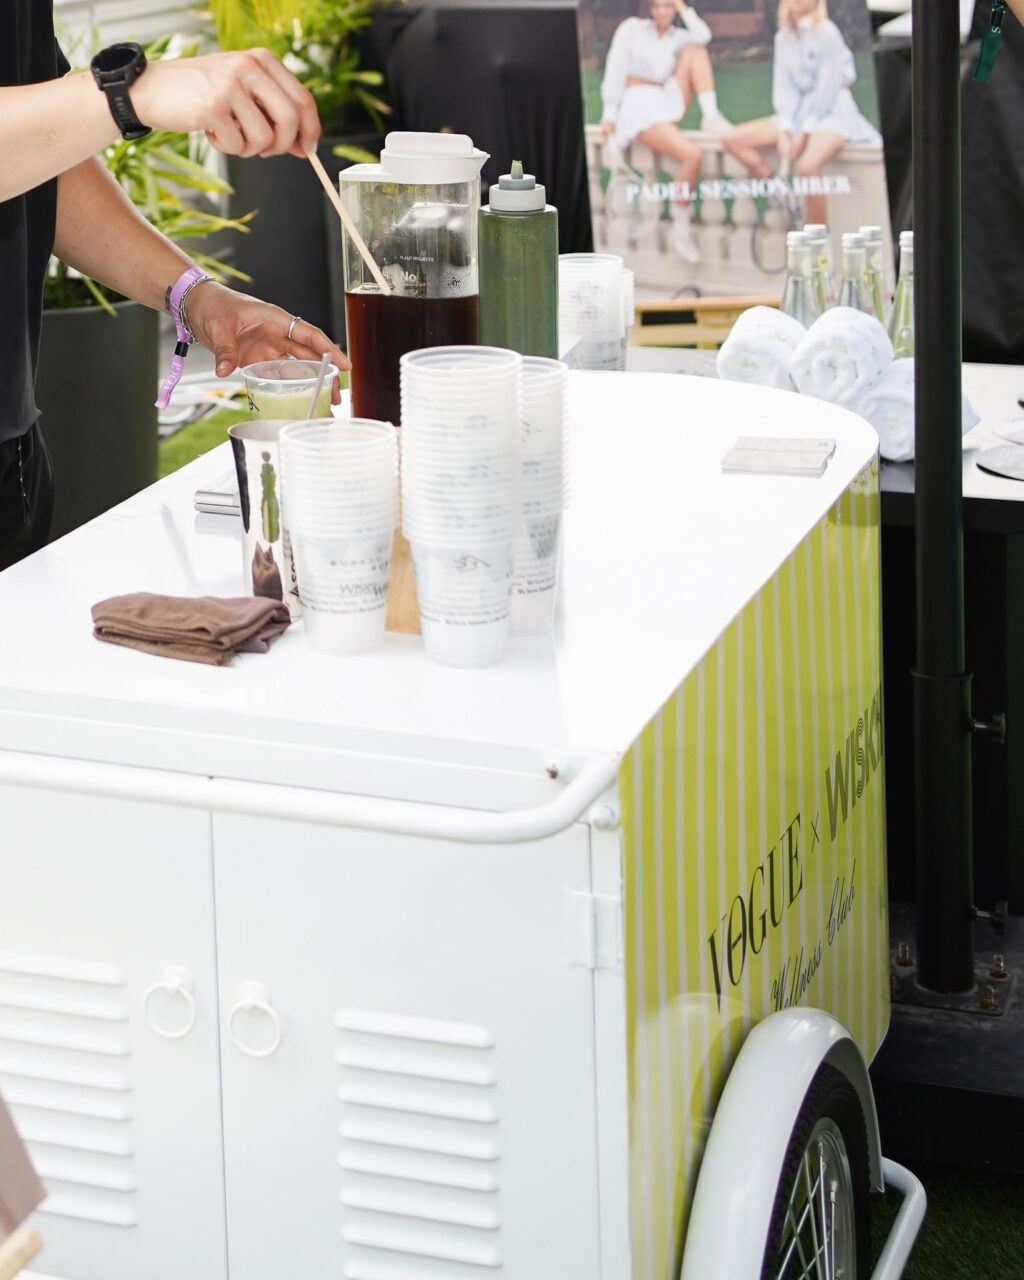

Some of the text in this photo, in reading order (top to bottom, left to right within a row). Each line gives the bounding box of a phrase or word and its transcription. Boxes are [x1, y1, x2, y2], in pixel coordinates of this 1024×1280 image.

[626, 182, 697, 202] PADEL
[699, 178, 789, 200] SESSION
[707, 812, 803, 1015] VOGUE
